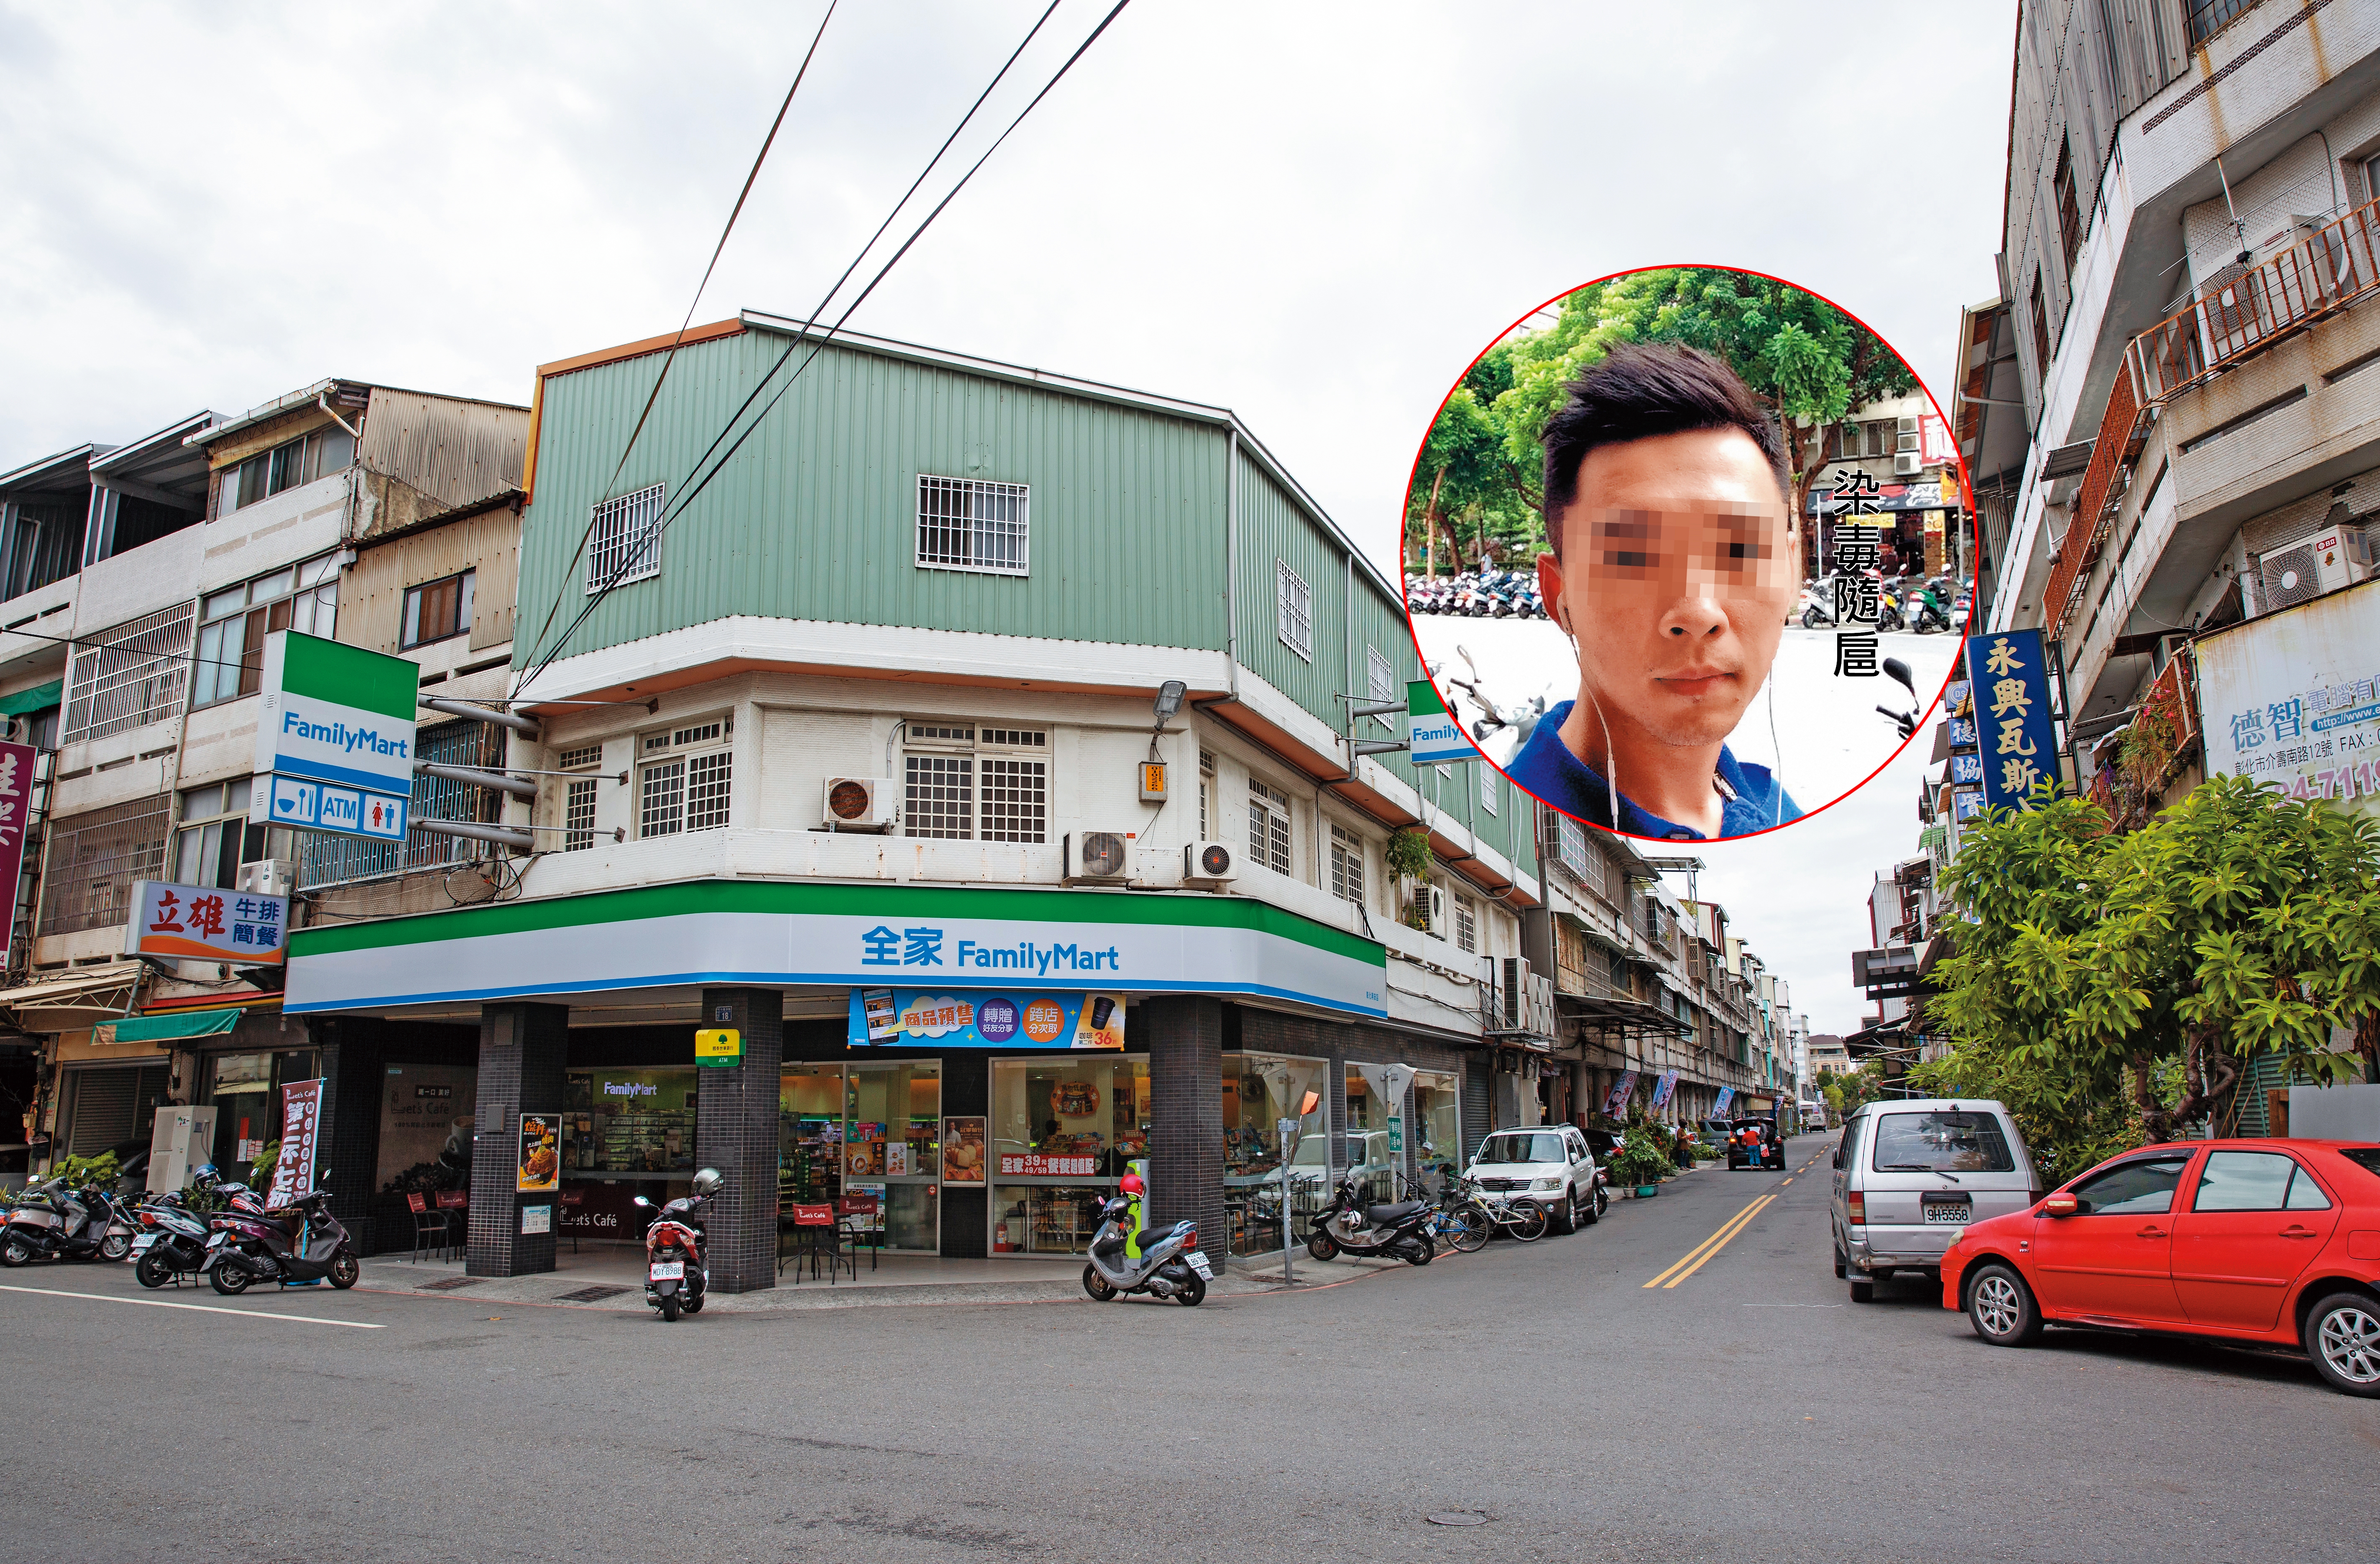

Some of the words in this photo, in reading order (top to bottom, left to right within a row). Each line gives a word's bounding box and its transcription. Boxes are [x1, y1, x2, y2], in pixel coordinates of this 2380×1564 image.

[1413, 725, 1464, 741] Family
[2230, 698, 2301, 752] 德智
[284, 711, 407, 758] FamilyMart
[2235, 739, 2333, 776] 彰化市介壽南路12號
[322, 796, 357, 820] ATM
[150, 889, 226, 939] 立雄
[236, 898, 280, 921] 牛排
[233, 923, 278, 947] 簡餐
[862, 926, 943, 966] 全家
[958, 940, 1119, 976] FamilyMart
[904, 1003, 974, 1027] 商品預售
[984, 1008, 1013, 1023] 轉贈
[1029, 1007, 1058, 1022] 跨店
[983, 1024, 1013, 1033] 好友分享
[1029, 1024, 1058, 1034] 分次取
[286, 1088, 304, 1100] Let's
[604, 1081, 657, 1098] FamilyMart
[267, 1101, 306, 1208] 第二杯七折
[1025, 1155, 1047, 1166] 39元
[1002, 1157, 1024, 1173] 全家
[1047, 1157, 1094, 1174] 餐餐超值配
[593, 1213, 617, 1226] Café
[798, 1209, 813, 1218] Let's
[1927, 1209, 1968, 1221] 9H-5558
[653, 1267, 681, 1276] MDY-8988
